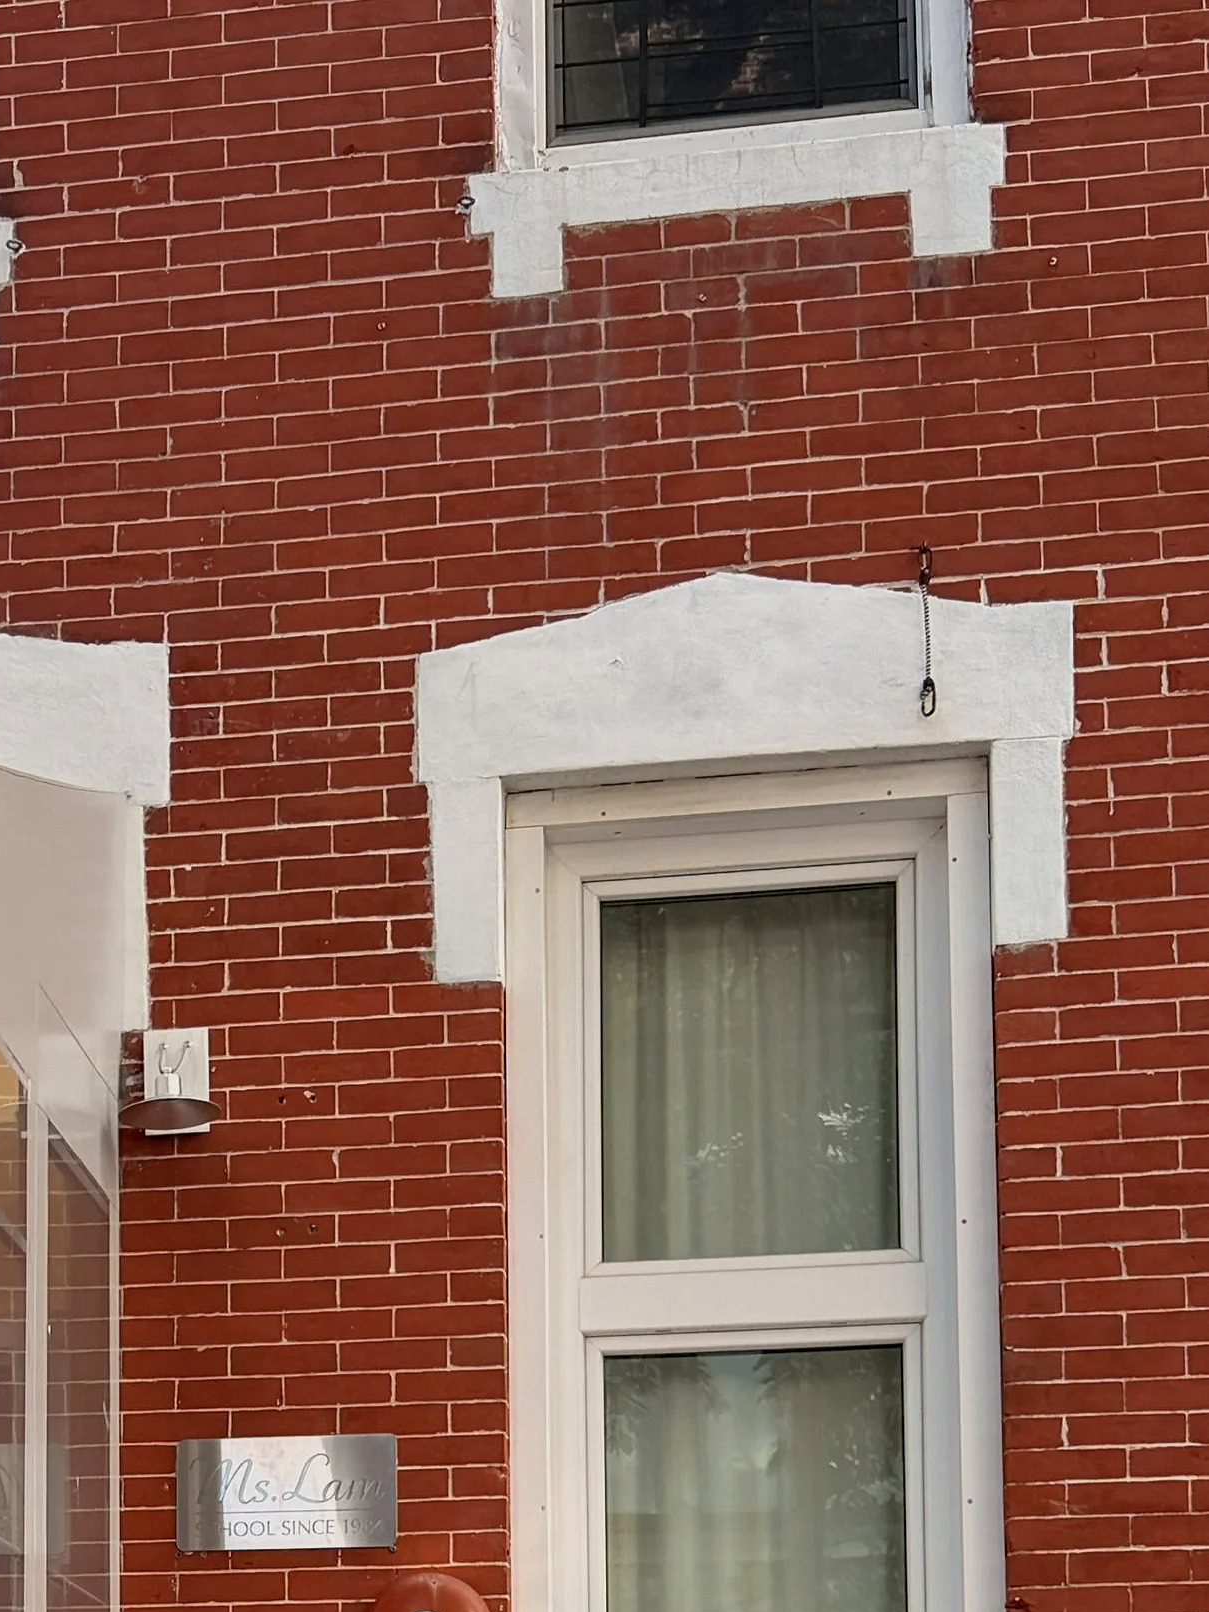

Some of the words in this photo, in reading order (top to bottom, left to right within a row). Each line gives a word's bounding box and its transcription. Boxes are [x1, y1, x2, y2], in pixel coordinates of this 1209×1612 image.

[195, 1519, 276, 1538] SHOOL
[281, 1519, 335, 1536] SINCE
[343, 1517, 384, 1535] 19
